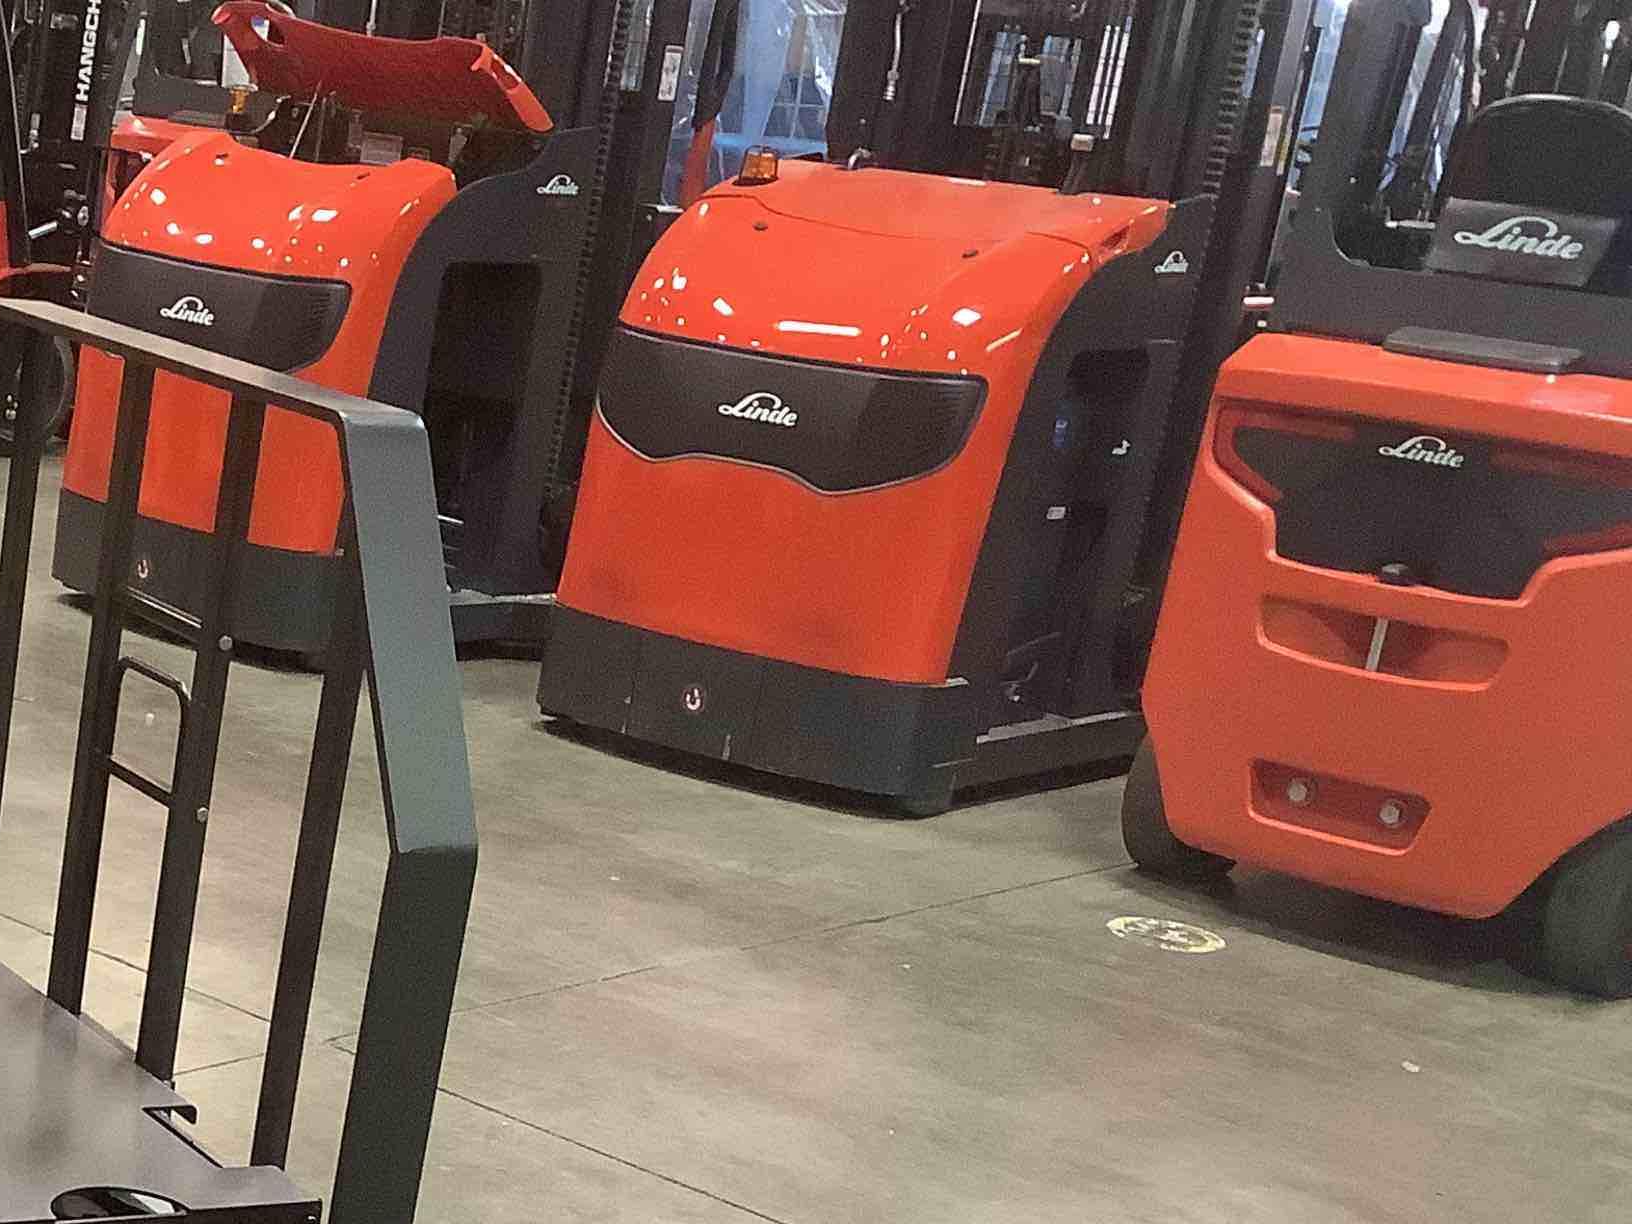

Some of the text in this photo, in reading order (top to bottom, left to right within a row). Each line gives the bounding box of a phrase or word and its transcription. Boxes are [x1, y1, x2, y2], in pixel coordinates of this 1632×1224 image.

[1454, 216, 1583, 259] Linde
[160, 296, 214, 326] Linde
[718, 392, 798, 426] Linde
[1378, 436, 1464, 468] Linde
